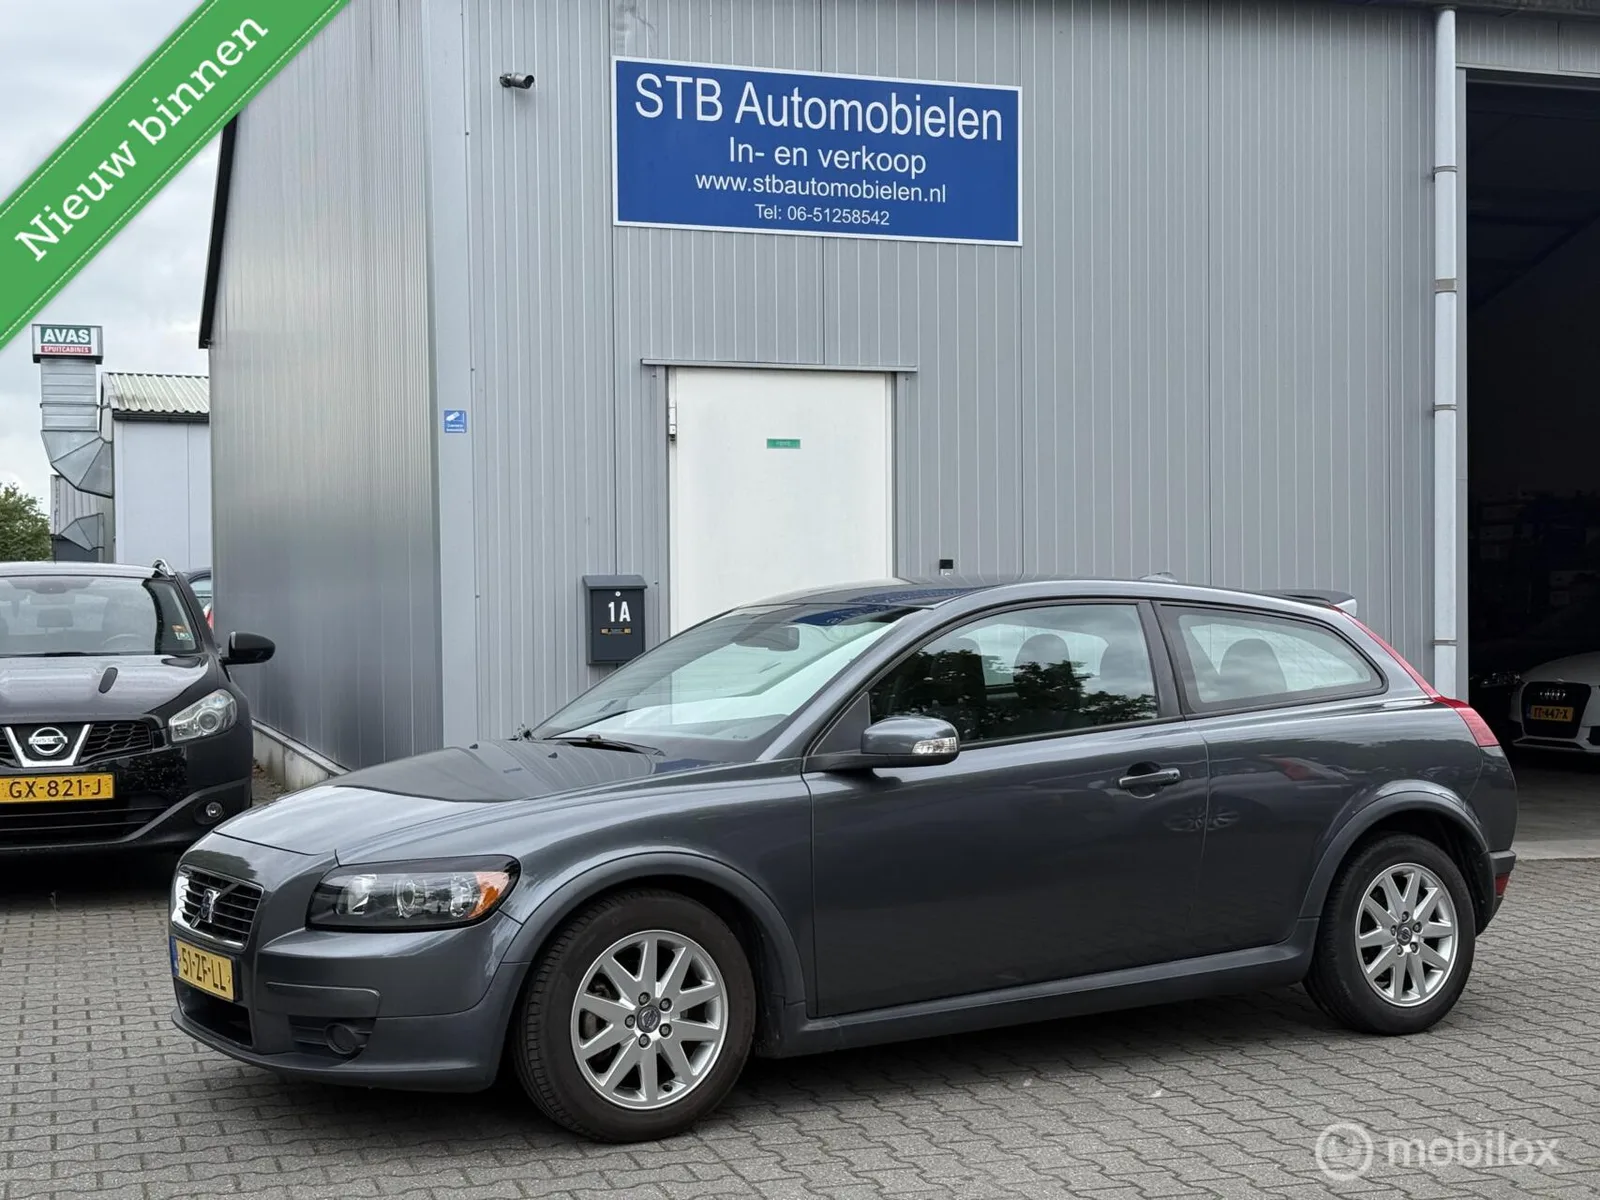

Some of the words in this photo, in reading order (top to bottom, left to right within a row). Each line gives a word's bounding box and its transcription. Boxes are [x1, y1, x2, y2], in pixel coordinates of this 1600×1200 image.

[634, 72, 723, 122] STB
[735, 81, 1003, 141] Automobielen
[729, 137, 765, 163] In-
[774, 147, 808, 168] en
[817, 146, 927, 179] verkoop
[695, 173, 947, 204] www.stbautomobielen.nl
[754, 204, 782, 221] Tel:
[787, 205, 890, 227] 06-51258542
[43, 328, 90, 343] AVAS
[9, 778, 101, 798] GX-821-J
[181, 947, 226, 991] 51-ZF-LL
